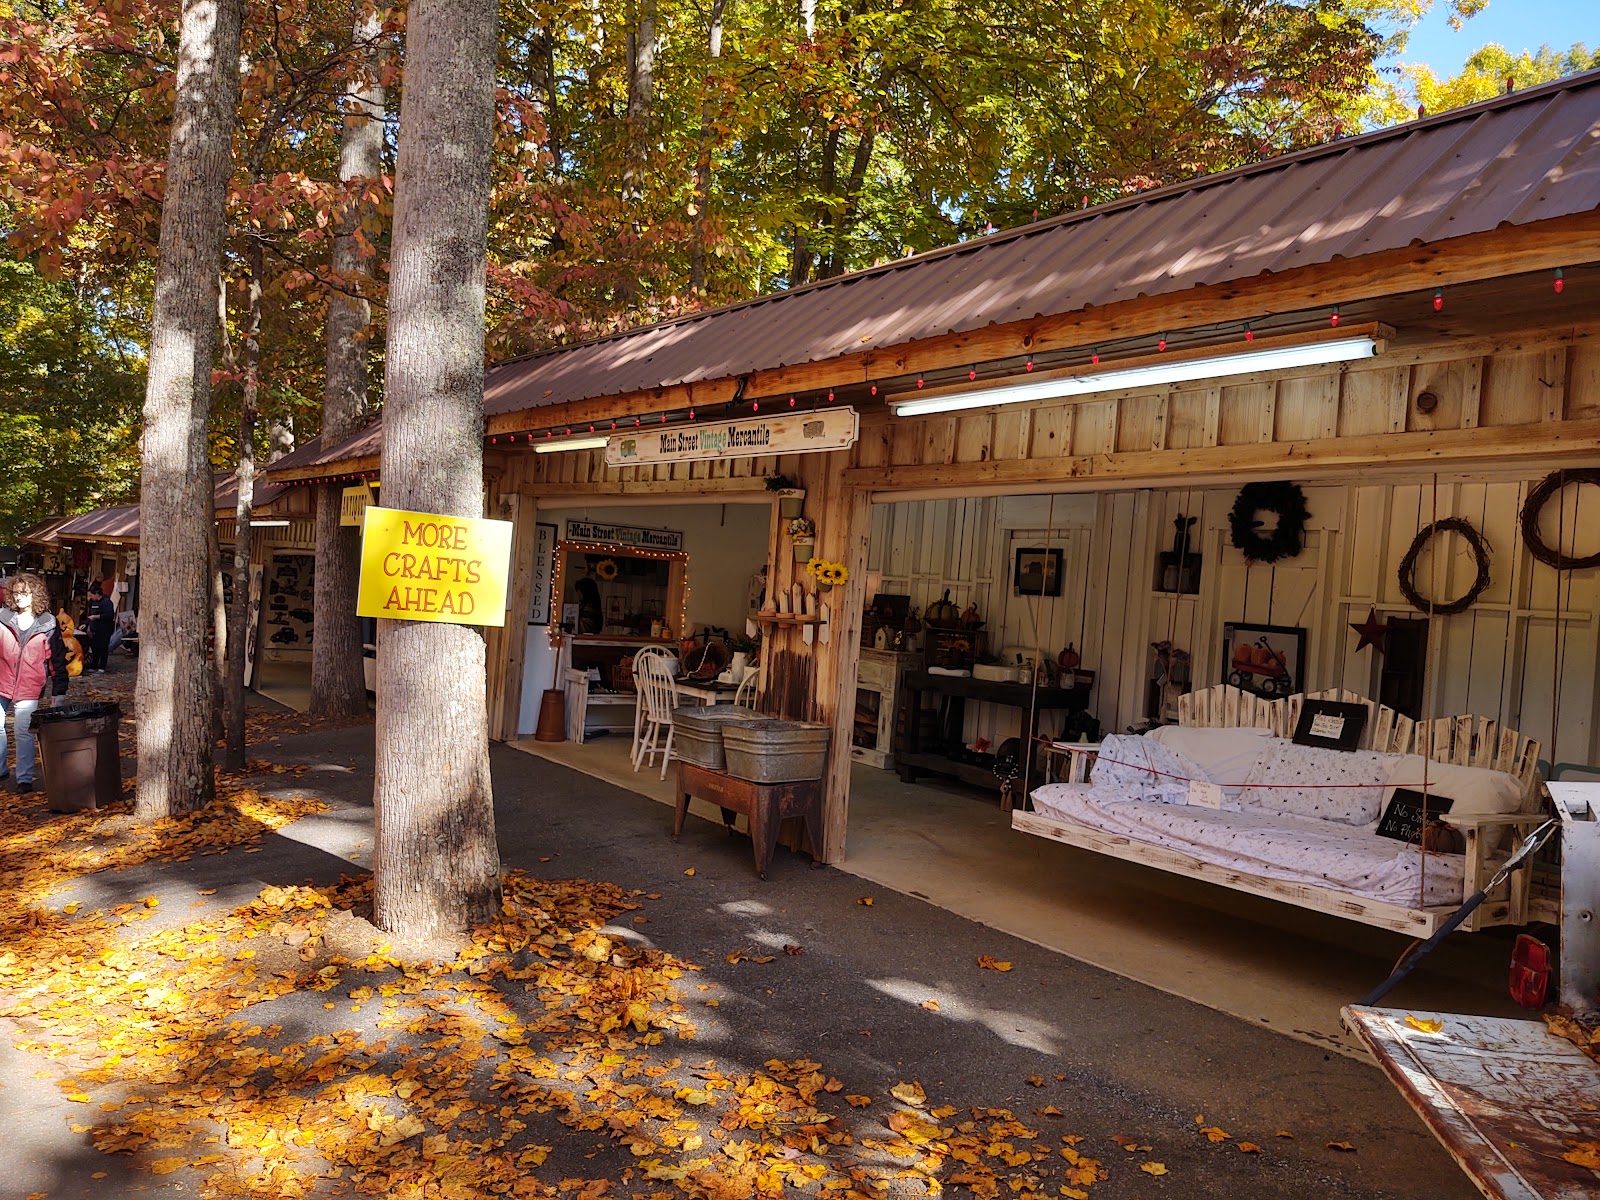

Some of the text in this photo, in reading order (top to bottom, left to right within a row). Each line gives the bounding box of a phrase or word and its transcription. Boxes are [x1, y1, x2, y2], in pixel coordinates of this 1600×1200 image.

[659, 424, 770, 453] Main Street Vintage Mercantile
[402, 521, 468, 550] MORE
[571, 524, 677, 546] Main Street Vintage Mercantile
[383, 552, 482, 584] CRAFTS
[532, 529, 546, 619] BLESSED
[383, 585, 476, 615] AHEAD
[1393, 803, 1409, 818] No
[1385, 819, 1398, 832] No
